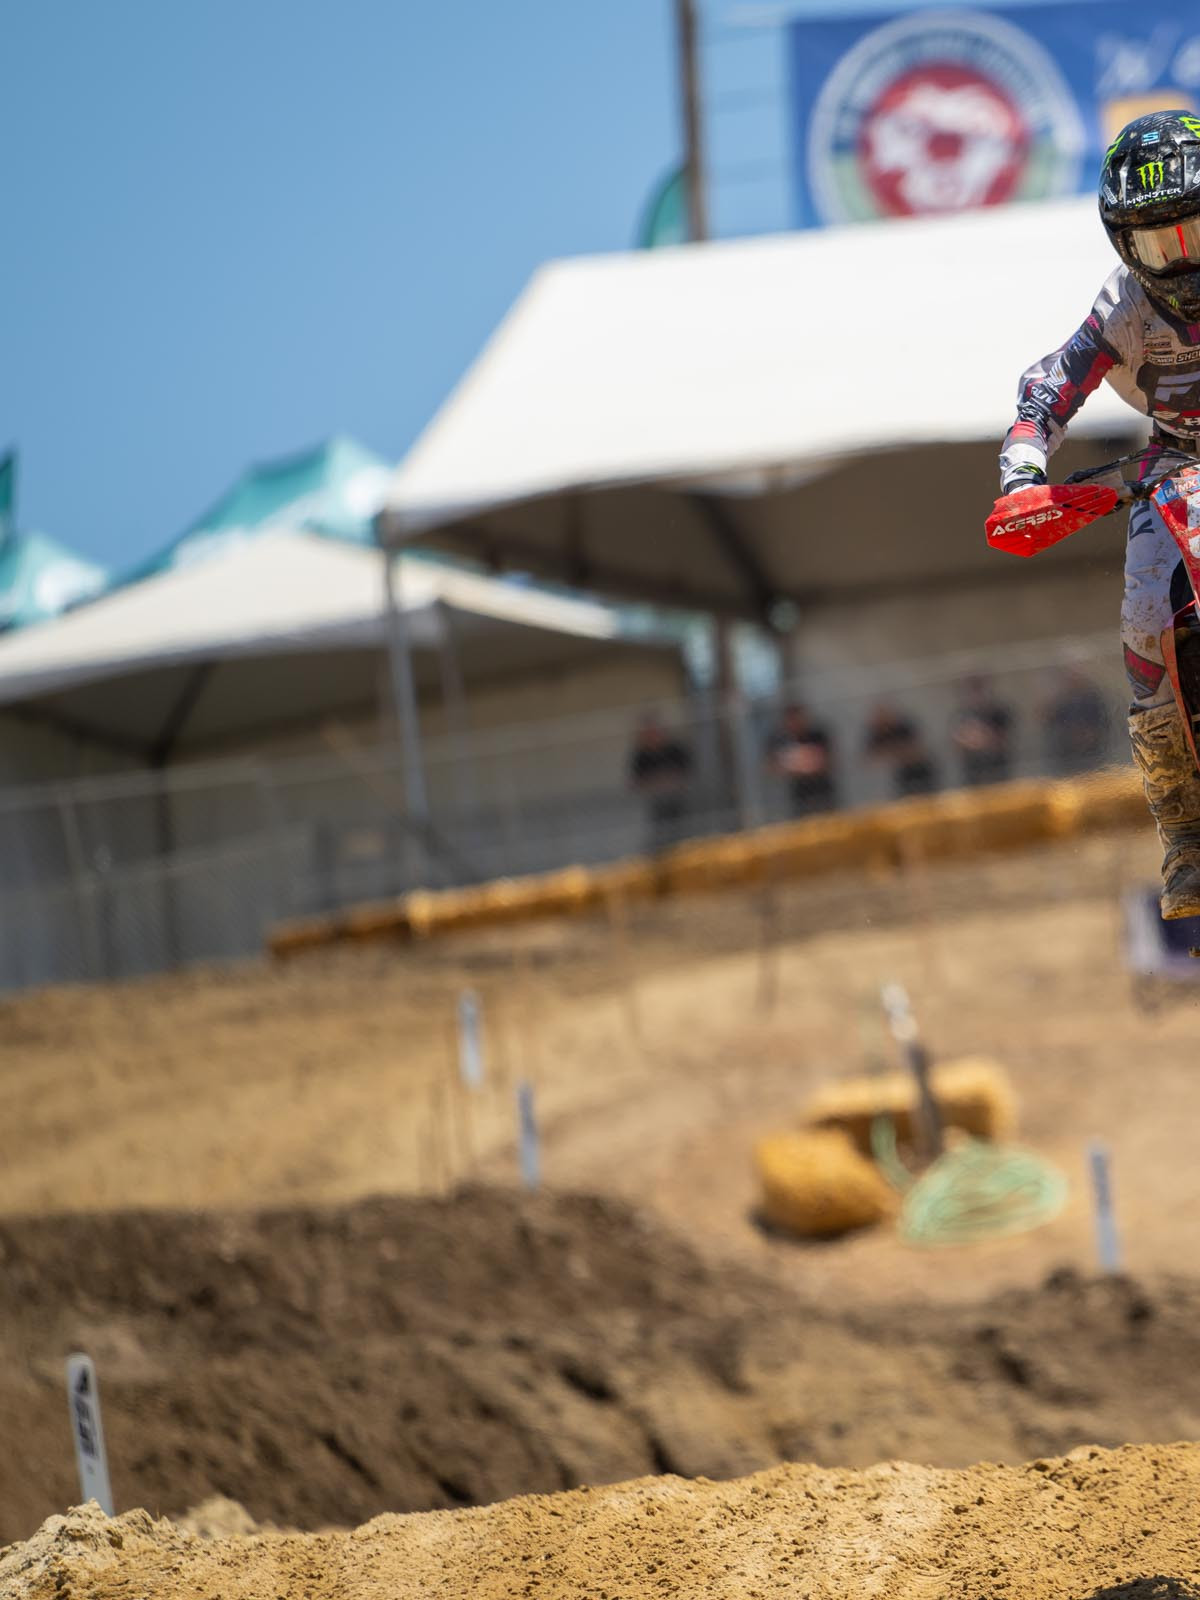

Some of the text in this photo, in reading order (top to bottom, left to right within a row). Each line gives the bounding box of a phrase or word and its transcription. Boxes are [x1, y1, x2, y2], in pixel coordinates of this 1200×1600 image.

[1127, 187, 1182, 206] MONSTER
[1164, 478, 1200, 501] WMX
[992, 509, 1063, 537] ACERBIS
